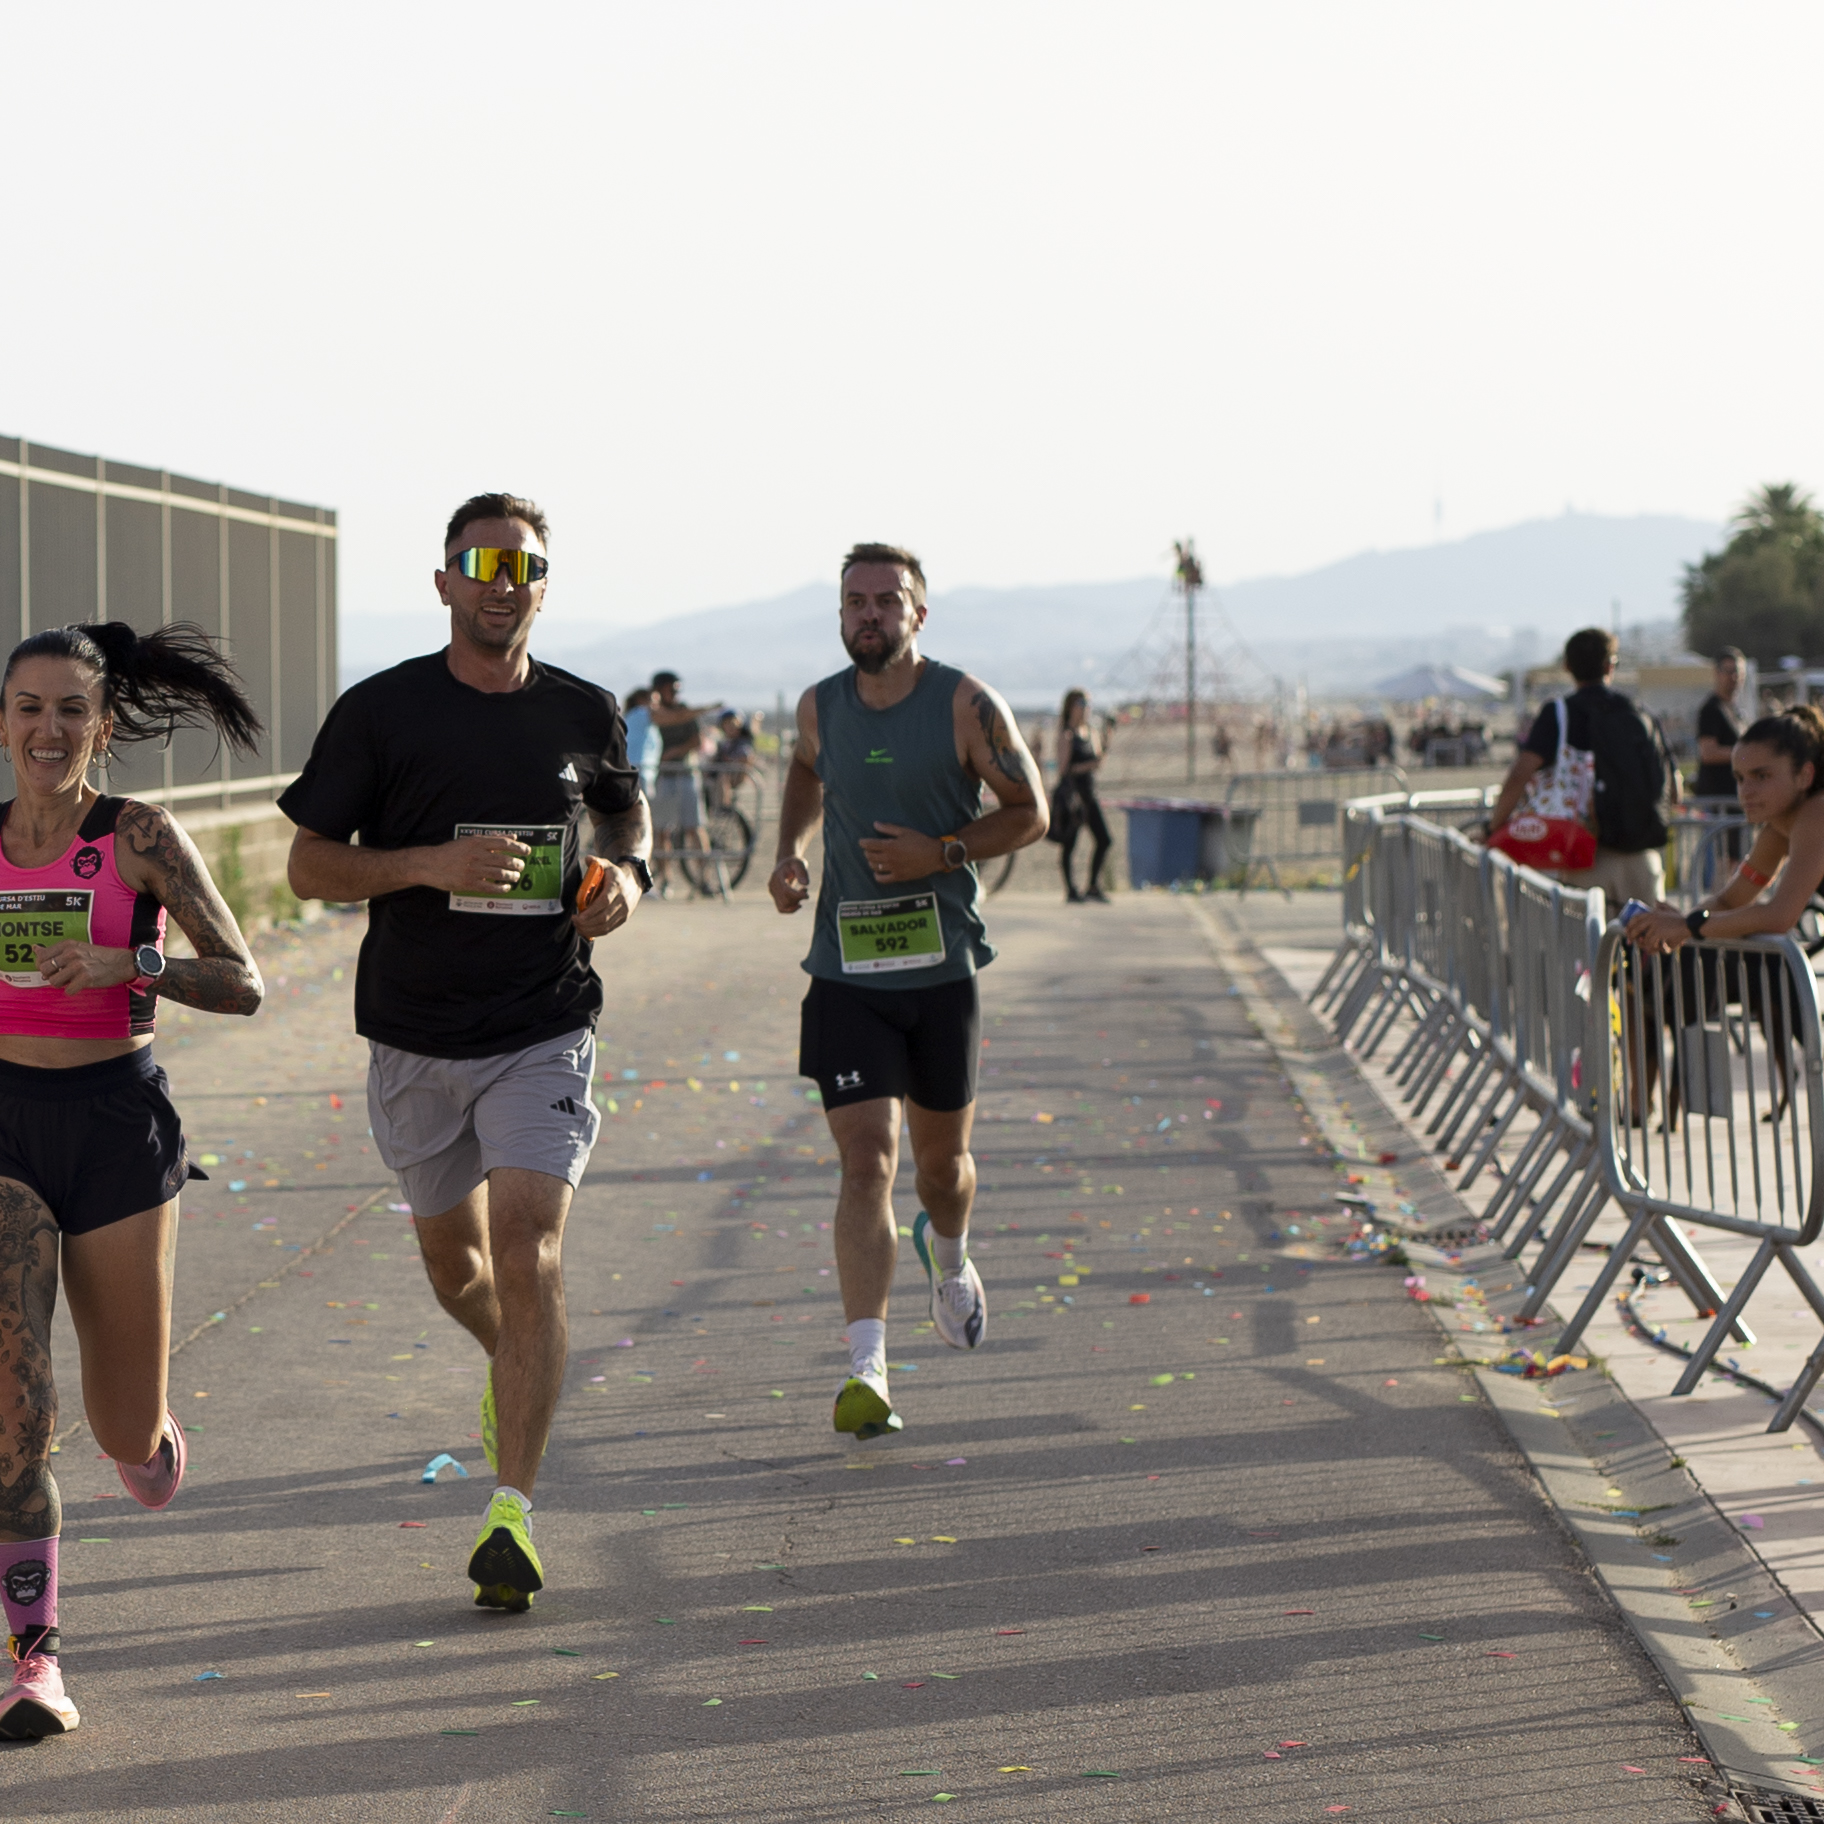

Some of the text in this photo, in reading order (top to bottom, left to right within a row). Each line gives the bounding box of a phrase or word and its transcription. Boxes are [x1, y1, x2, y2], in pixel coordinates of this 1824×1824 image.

[65, 896, 82, 907] 5K
[850, 917, 928, 936] SALVADOR
[4, 943, 47, 963] 52
[875, 936, 910, 953] 592
